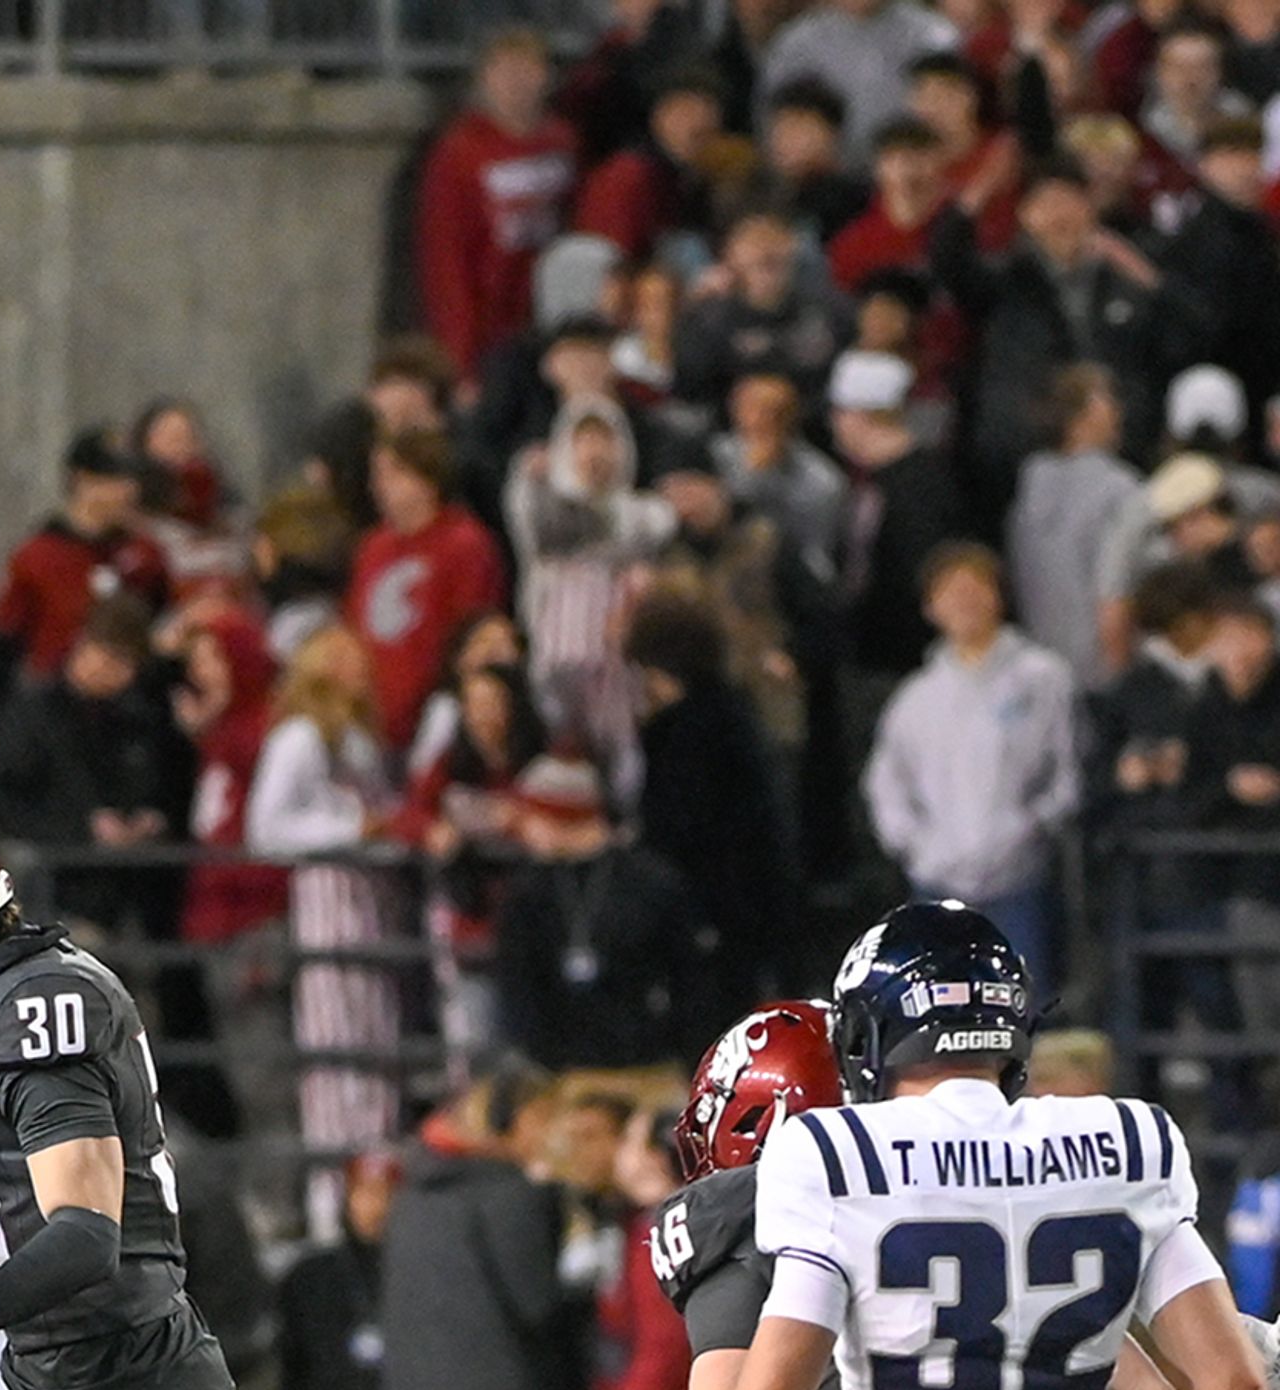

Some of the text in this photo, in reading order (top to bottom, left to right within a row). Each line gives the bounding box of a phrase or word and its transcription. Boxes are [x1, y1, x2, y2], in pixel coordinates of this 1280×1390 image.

[16, 993, 86, 1060] 30
[934, 1031, 1013, 1053] AGGIES
[892, 1131, 1122, 1188] T. WILLIAMS
[641, 1202, 695, 1282] 46
